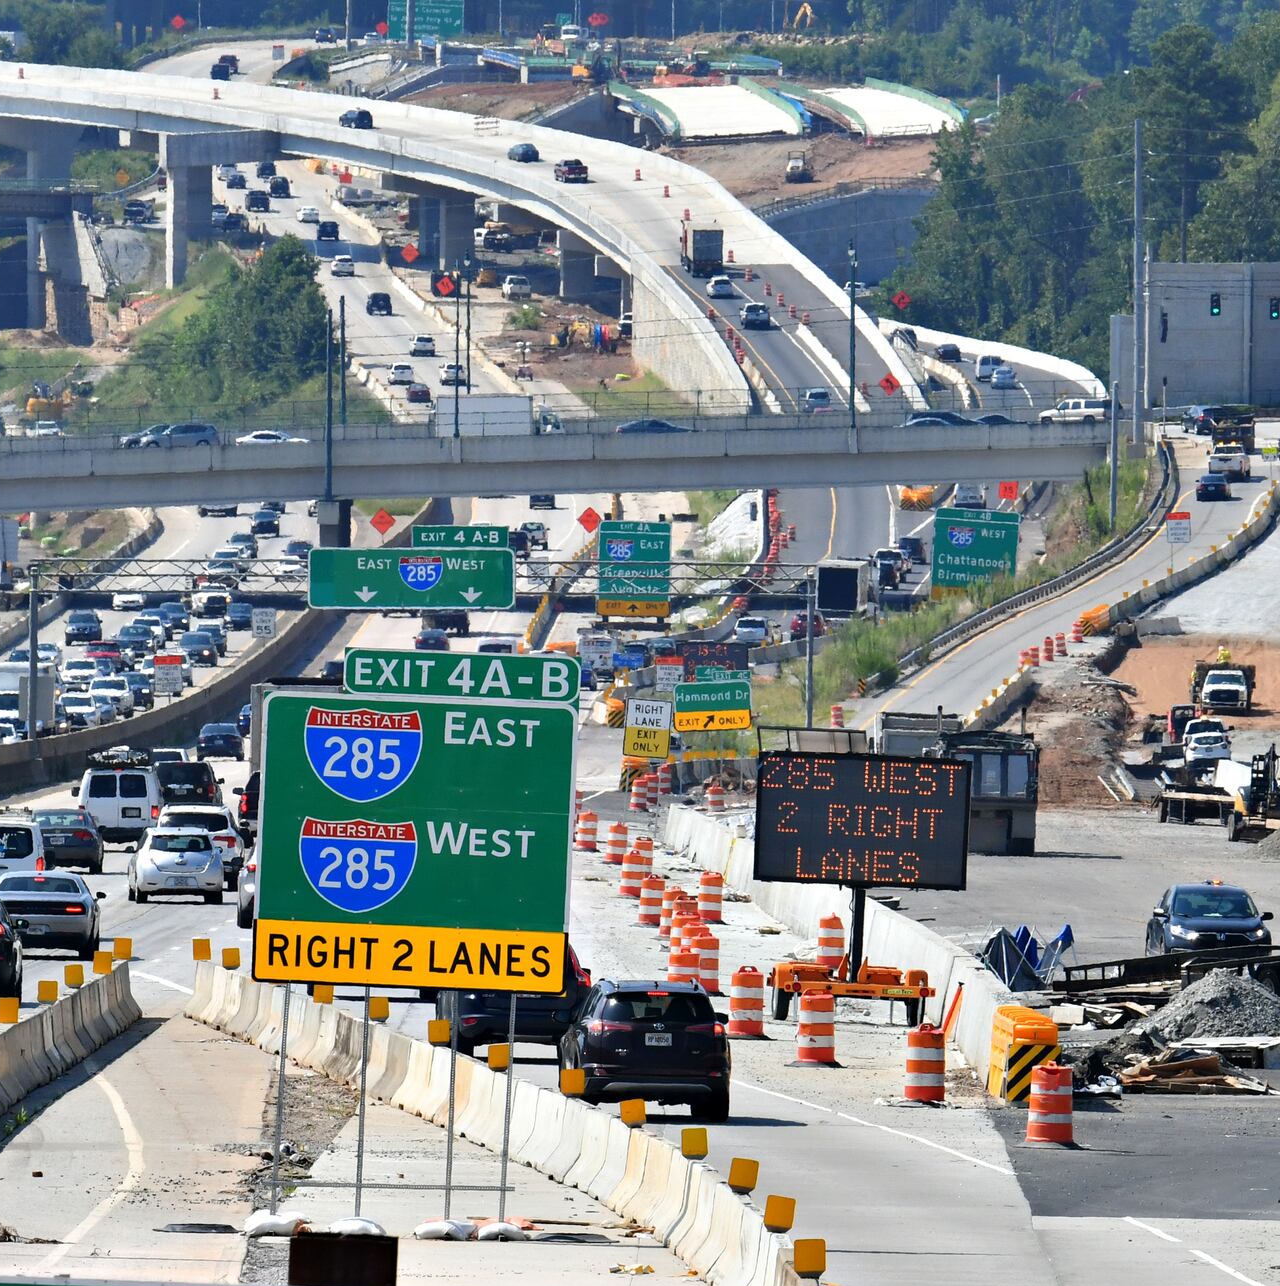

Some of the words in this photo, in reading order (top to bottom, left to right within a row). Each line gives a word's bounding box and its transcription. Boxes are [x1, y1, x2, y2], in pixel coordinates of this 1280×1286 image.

[421, 532, 446, 541] EXIT
[454, 530, 465, 542] 4
[472, 531, 499, 543] A-B
[952, 531, 972, 544] 285
[981, 528, 1006, 539] WEST
[610, 544, 631, 558] 285
[640, 540, 664, 549] EAST
[357, 557, 392, 570] EAST
[446, 557, 486, 570] WEST
[938, 553, 1011, 568] Chattanooga
[406, 565, 436, 582] 285
[256, 625, 272, 635] 55
[354, 657, 436, 688] EXIT
[447, 658, 570, 698] 4A-B
[675, 691, 731, 703] Hammond
[735, 690, 749, 700] Dr
[635, 704, 664, 715] RIGHT
[316, 711, 412, 729] INTERSTATE
[444, 711, 541, 748] EAST
[635, 718, 661, 727] LANE
[678, 718, 700, 727] EXIT
[718, 716, 745, 726] ONLY
[637, 729, 657, 739] EXIT
[632, 742, 660, 753] ONLY
[323, 736, 401, 780] 285
[762, 757, 836, 790] 285
[864, 761, 962, 796] WEST
[777, 802, 799, 832] 2
[828, 803, 944, 840] RIGHT
[311, 823, 406, 840] INTERSTATE
[426, 821, 536, 858] WEST
[318, 846, 396, 891] 285
[796, 846, 920, 883] LANES
[268, 933, 379, 970] RIGHT
[392, 939, 414, 972] 2
[428, 940, 551, 978] LANES
